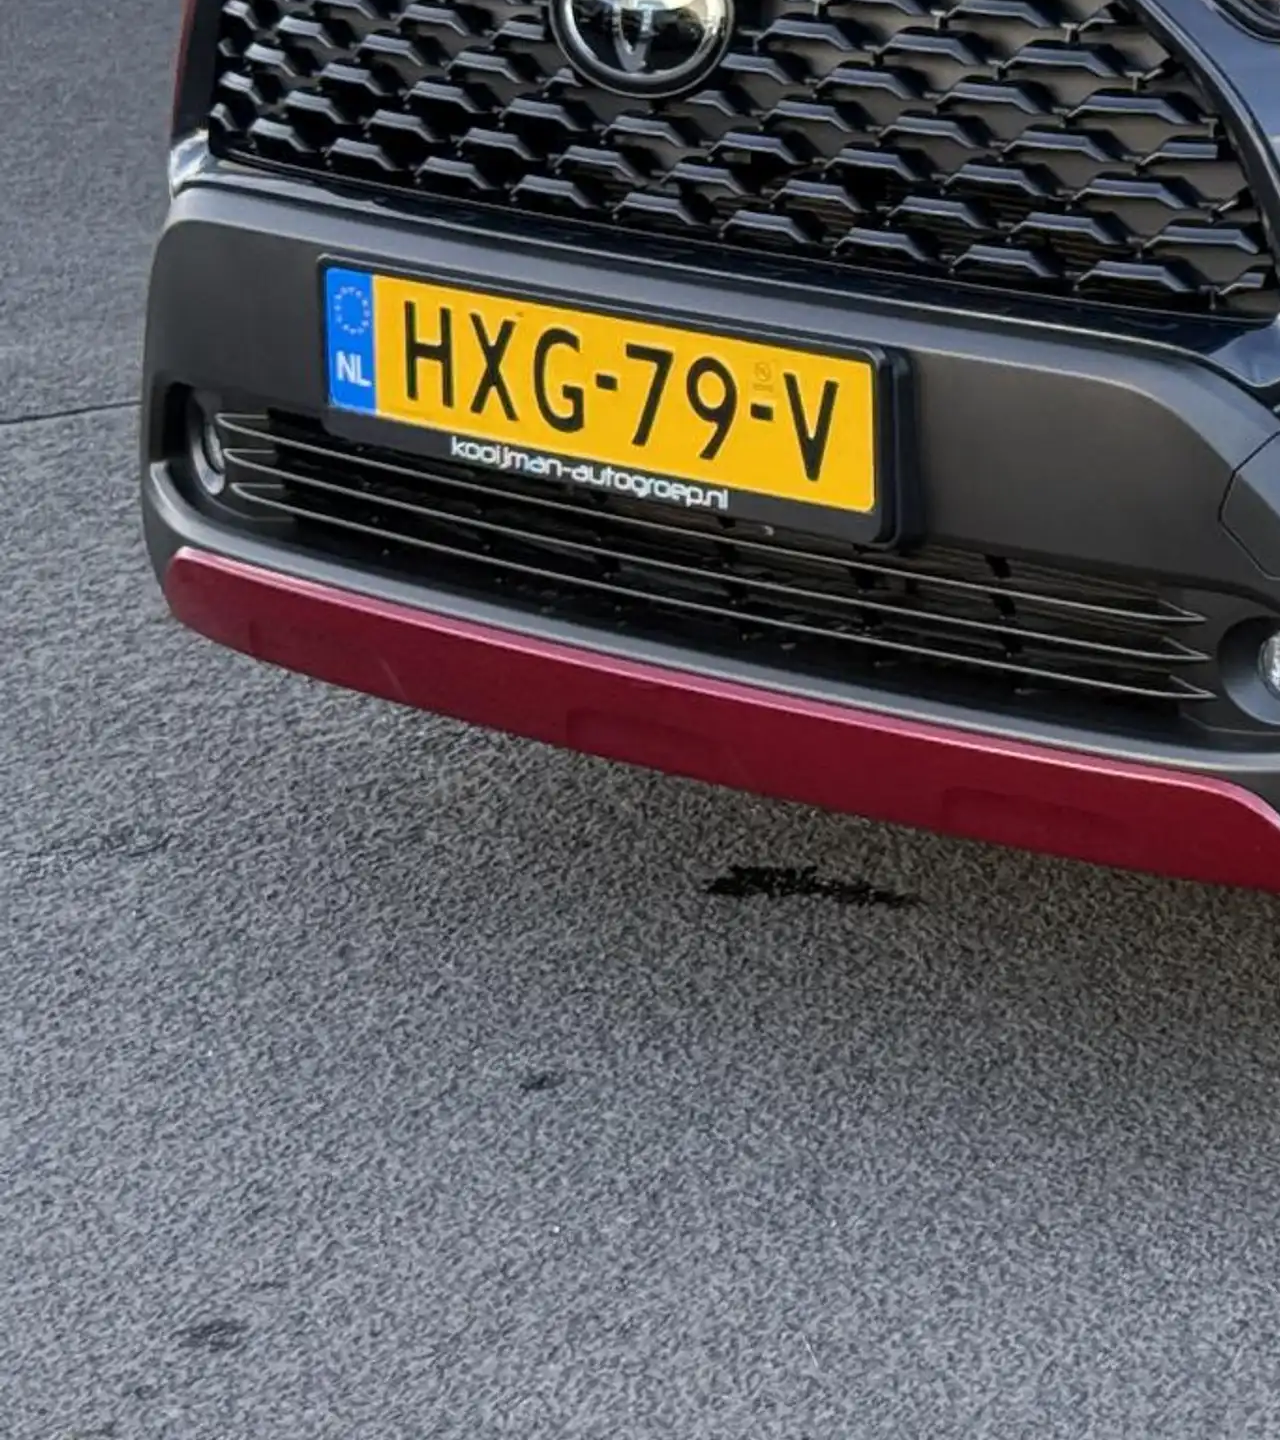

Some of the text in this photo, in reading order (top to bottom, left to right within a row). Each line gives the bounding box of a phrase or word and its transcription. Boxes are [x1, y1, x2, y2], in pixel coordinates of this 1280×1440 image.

[335, 349, 373, 390] NL
[402, 299, 840, 484] HXG-79-V
[449, 434, 730, 511] kooijman-autogroep.nl
